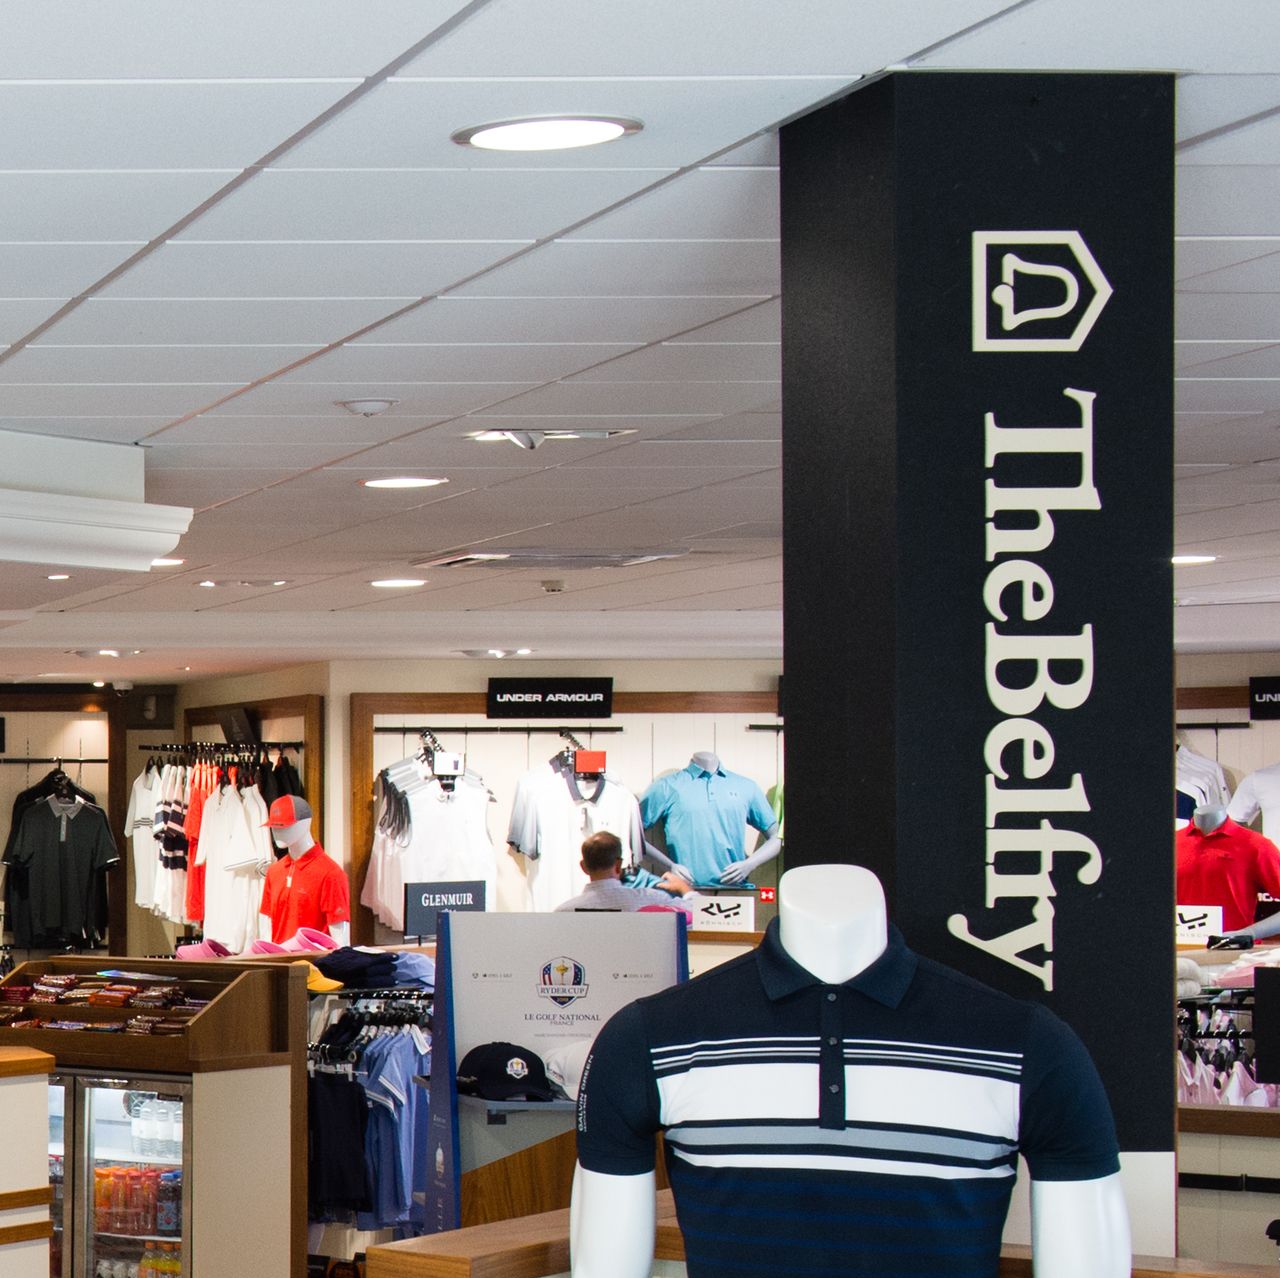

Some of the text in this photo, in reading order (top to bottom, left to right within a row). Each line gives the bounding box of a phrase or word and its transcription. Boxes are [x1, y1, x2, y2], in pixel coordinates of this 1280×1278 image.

[496, 693, 604, 702] UNDER ARMOUR
[421, 892, 474, 907] GLENMUIR
[568, 986, 585, 994] CUP
[524, 1013, 534, 1021] LE
[536, 1013, 558, 1021] GOLF
